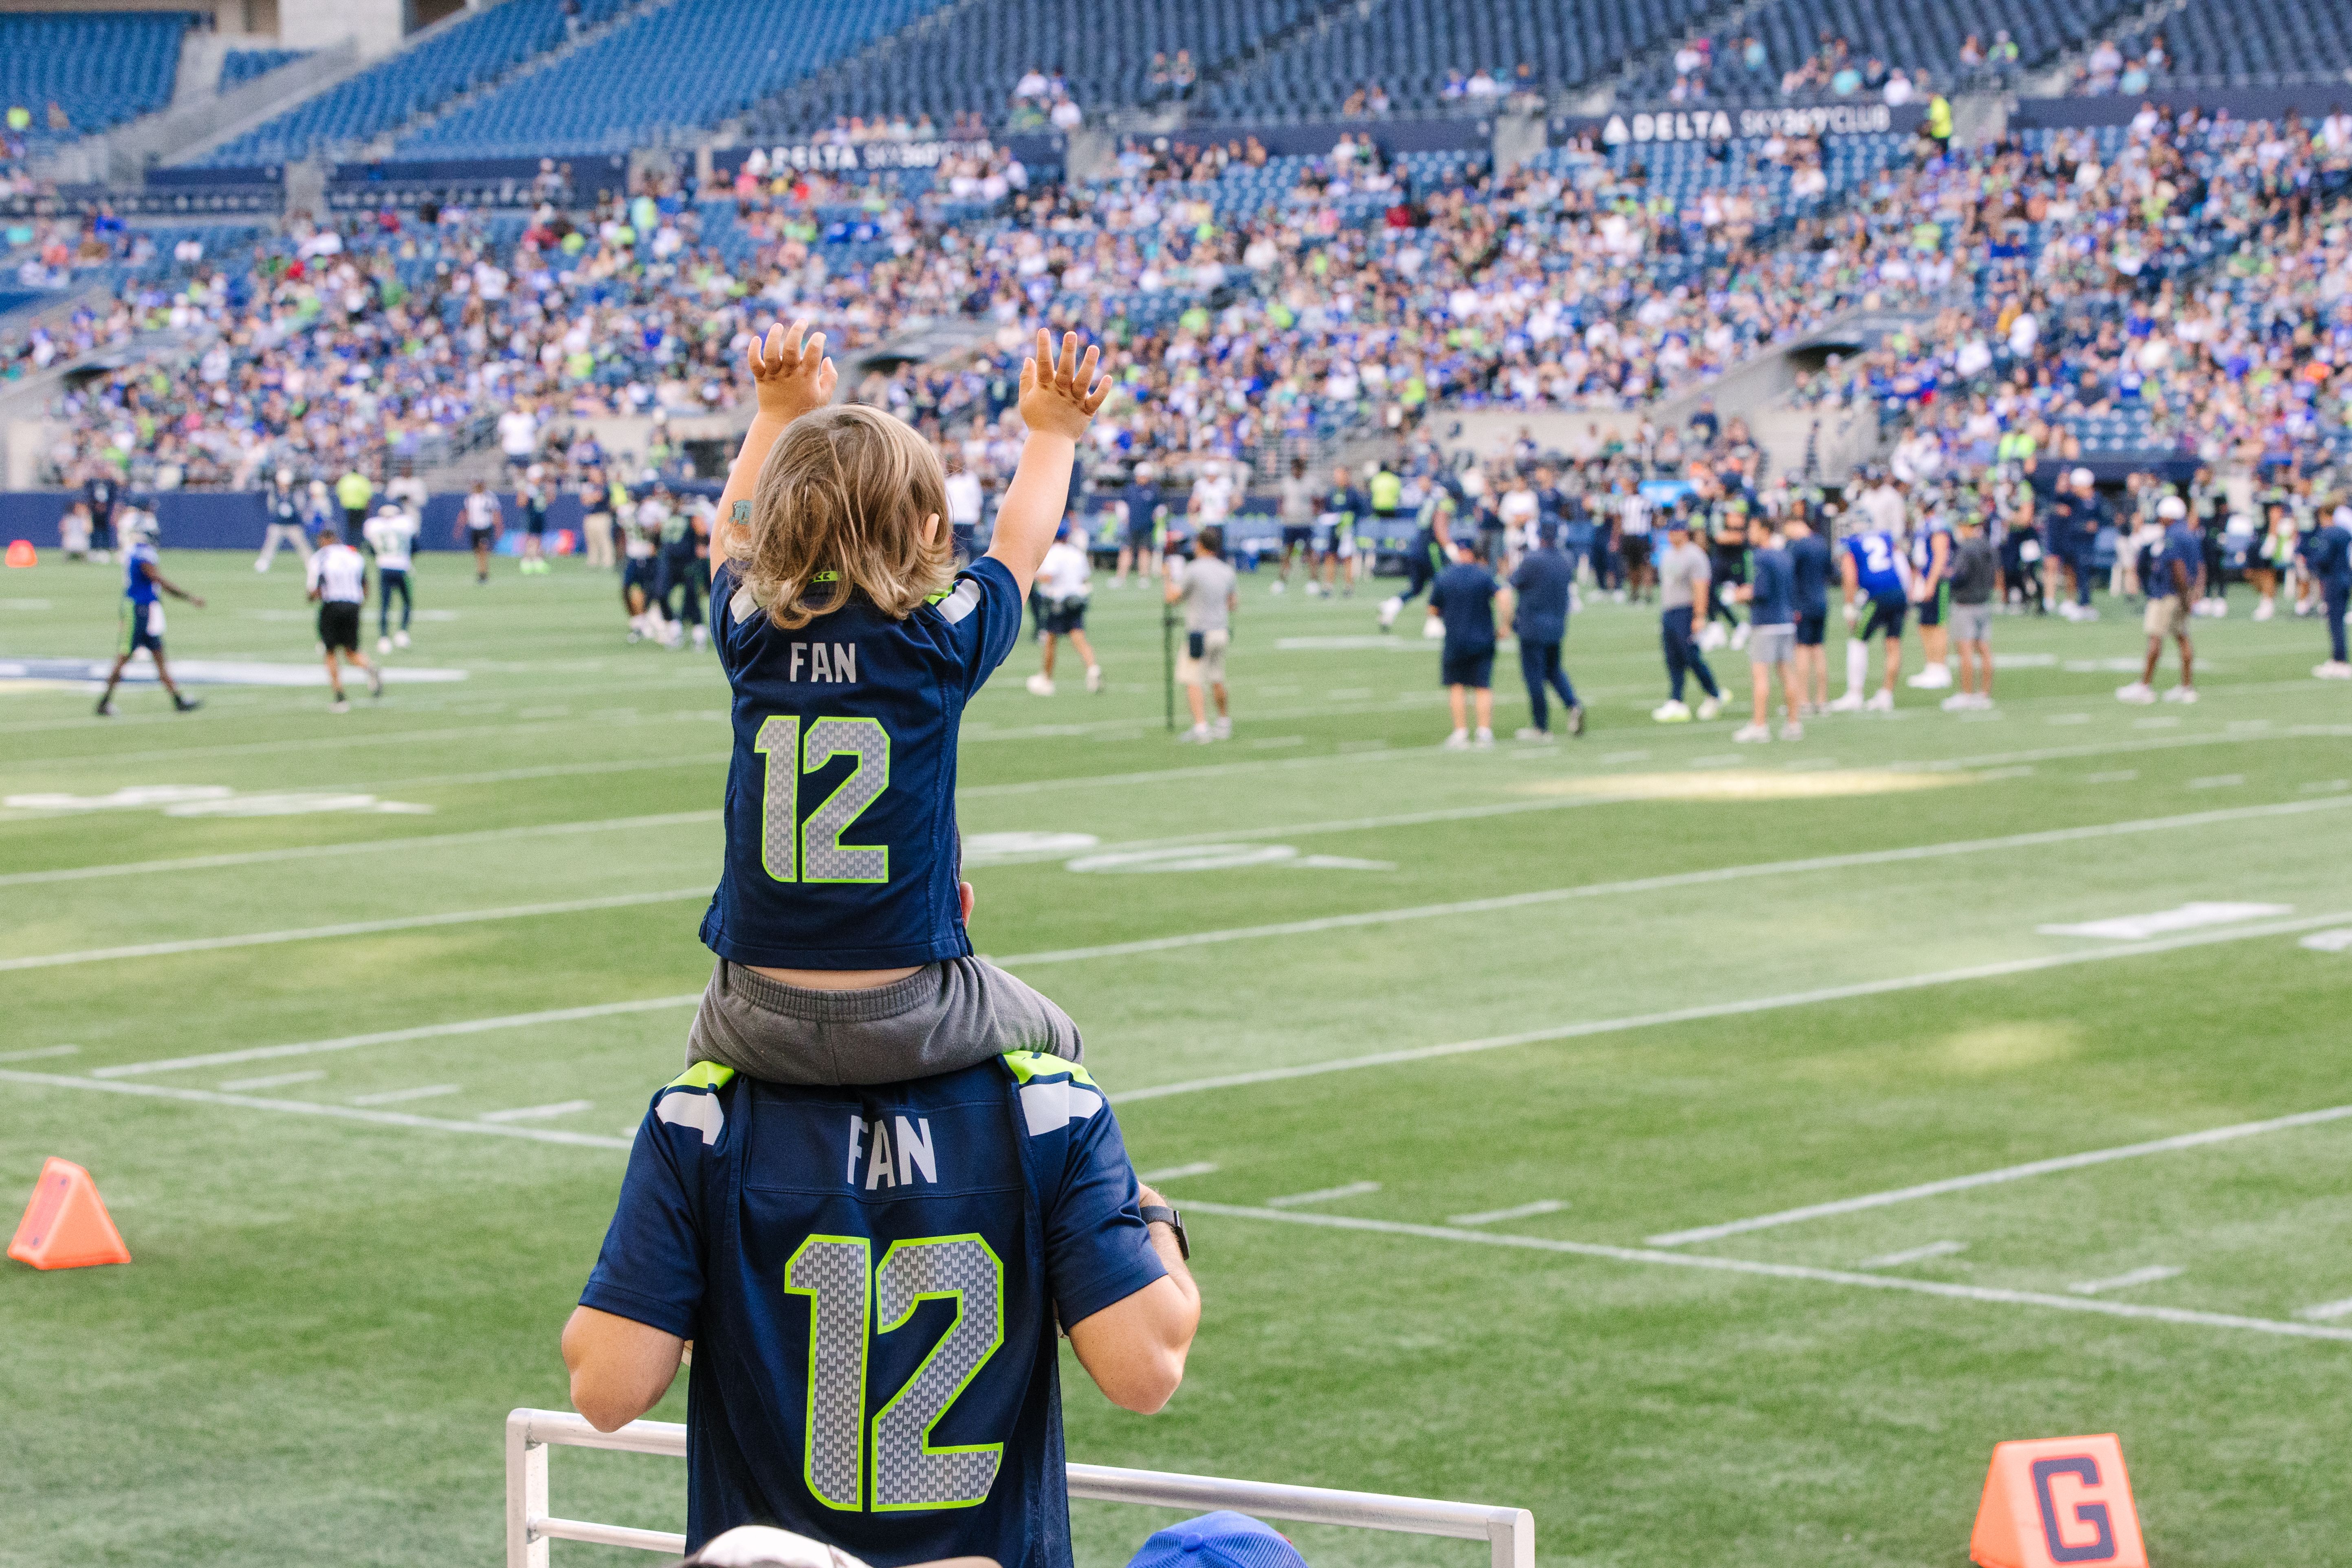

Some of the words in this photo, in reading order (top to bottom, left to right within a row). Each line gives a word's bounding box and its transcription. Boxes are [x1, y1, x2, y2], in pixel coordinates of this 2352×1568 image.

[1633, 110, 1732, 142] DELTA
[1830, 104, 1890, 134] CLUB
[772, 145, 858, 172] DELTA
[1861, 535, 1893, 573] 2
[790, 642, 856, 683] FAN
[754, 715, 891, 883] 12
[847, 1115, 937, 1190] FAN
[784, 1232, 1004, 1513] 12
[2032, 1456, 2116, 1563] G
